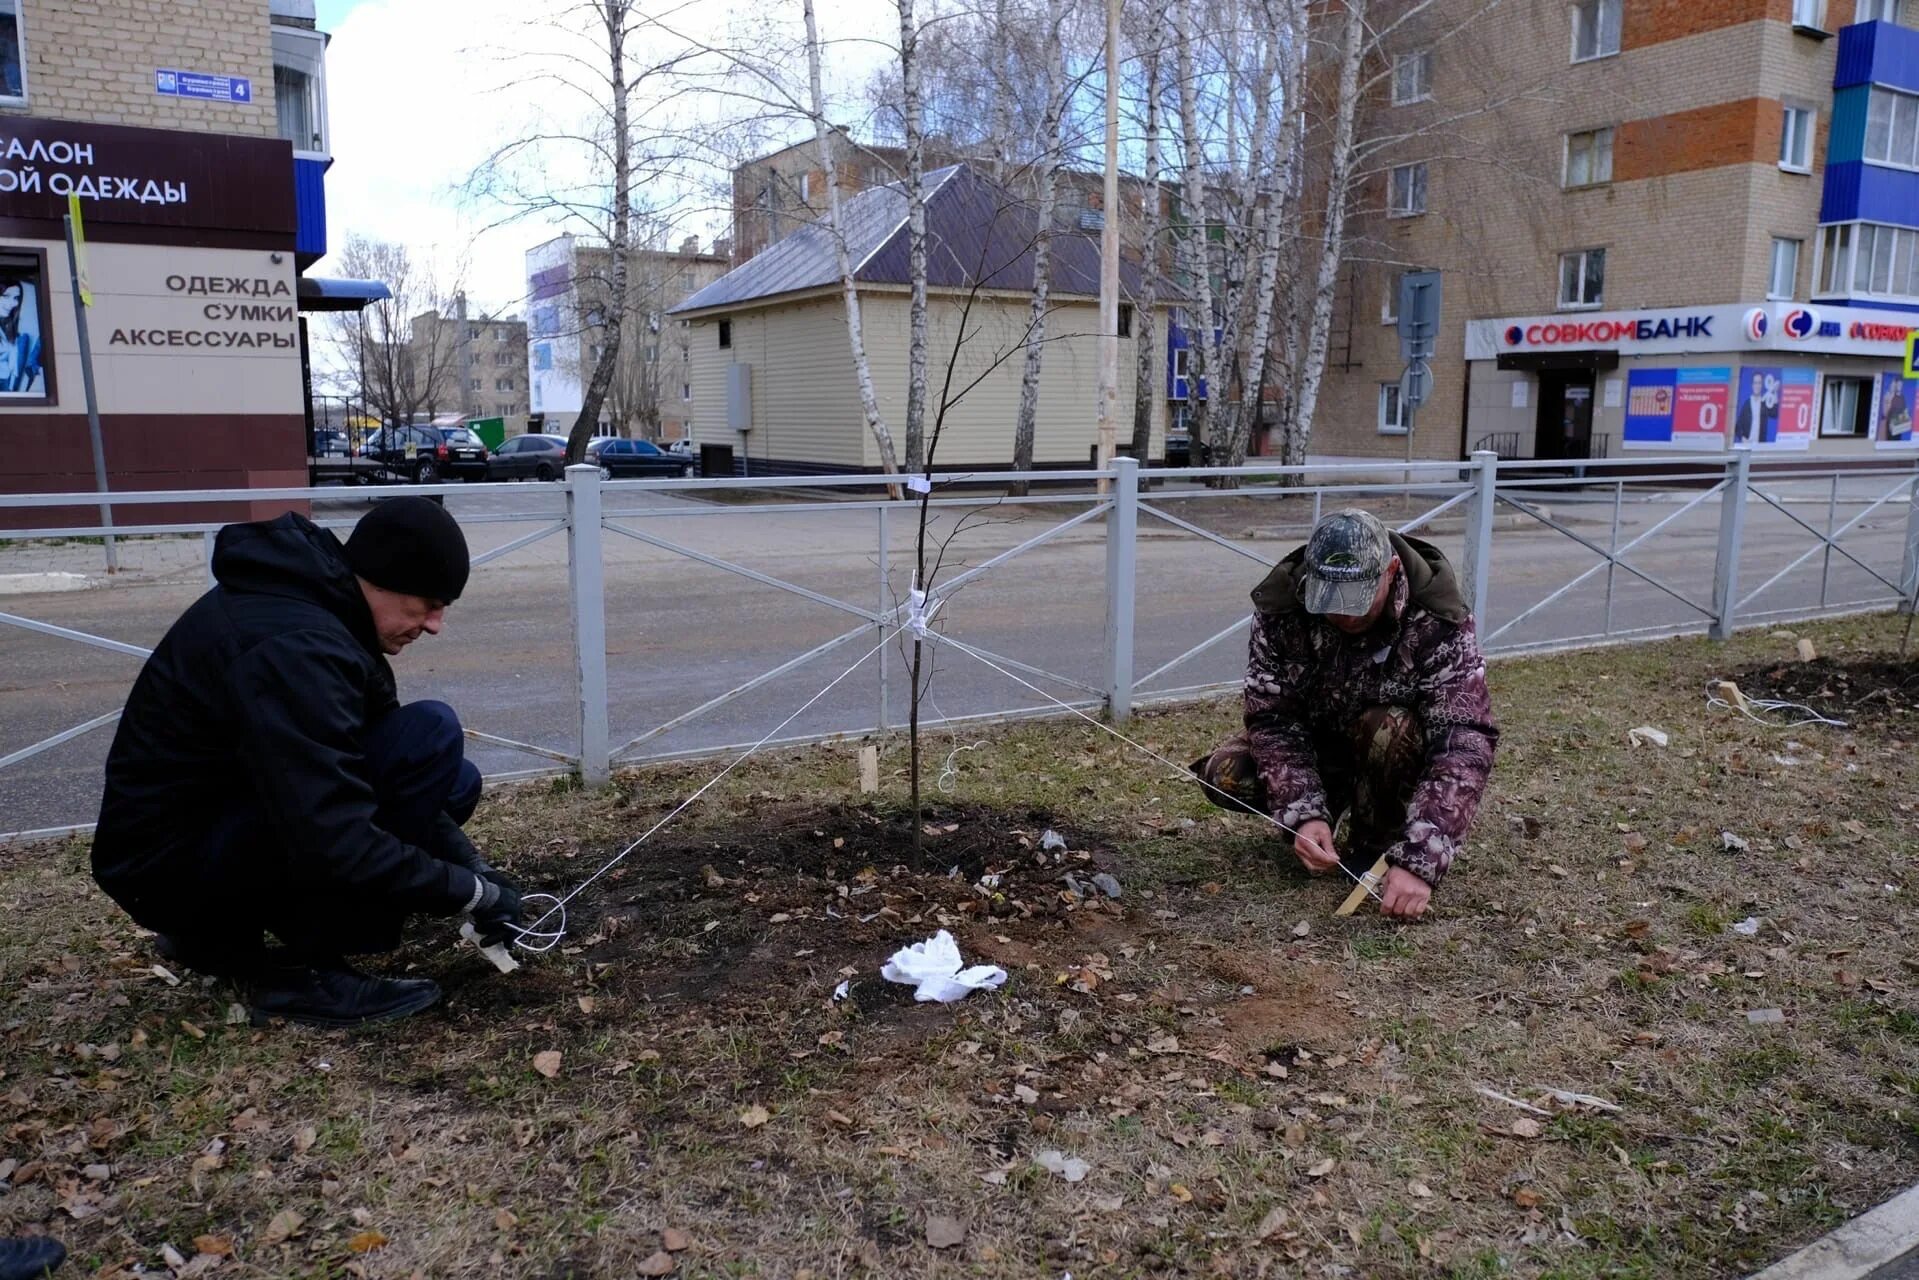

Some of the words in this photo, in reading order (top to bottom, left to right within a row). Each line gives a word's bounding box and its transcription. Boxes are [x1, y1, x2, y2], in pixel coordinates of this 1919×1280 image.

[235, 83, 245, 97] 4
[0, 137, 94, 166] АЛОН
[48, 173, 187, 205] ОДЕЖДЫ
[166, 275, 291, 297] ОДЕЖДА
[203, 303, 294, 322] СУМКИ
[109, 328, 296, 348] АКСЕССУАРЫ
[1526, 315, 1715, 344] СОВКОМБАНК
